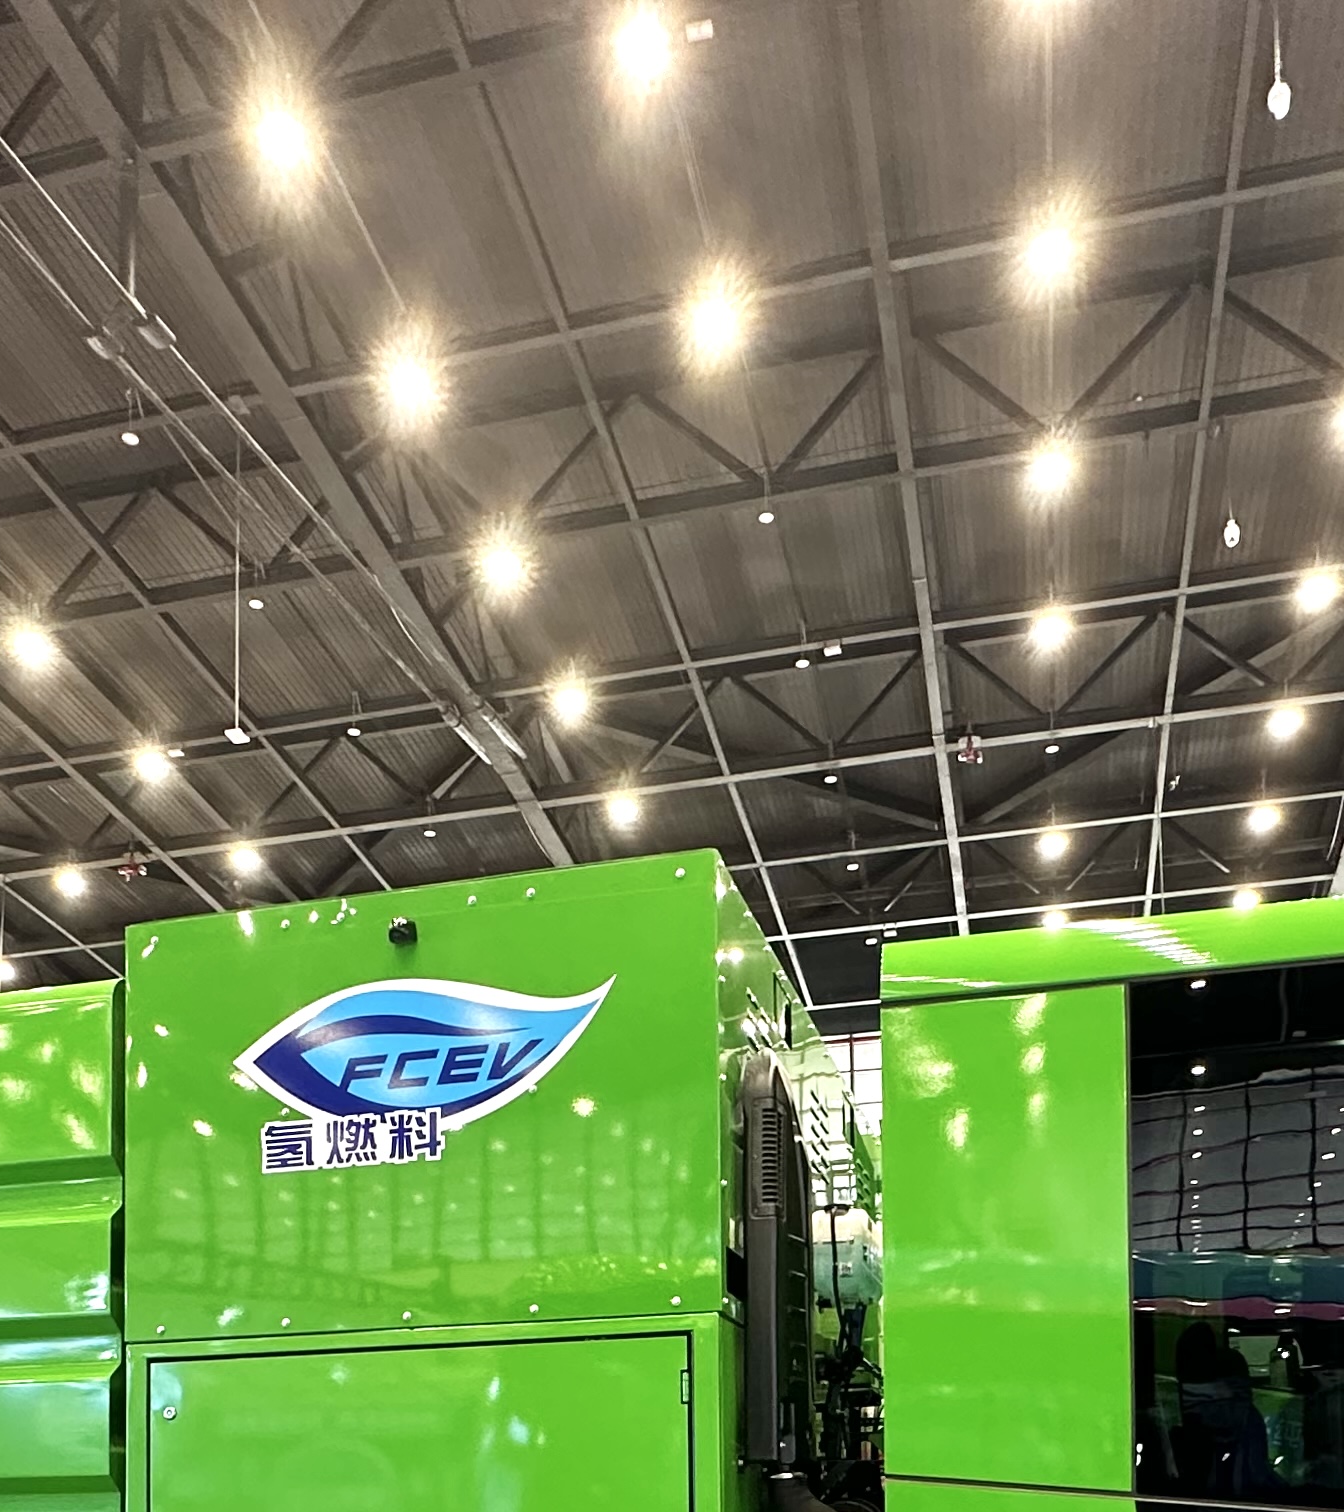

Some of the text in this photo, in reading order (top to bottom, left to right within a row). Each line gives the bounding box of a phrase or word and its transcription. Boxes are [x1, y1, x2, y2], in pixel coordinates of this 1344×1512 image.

[339, 1038, 545, 1092] FCEV
[264, 1110, 442, 1170] 氢燃料
